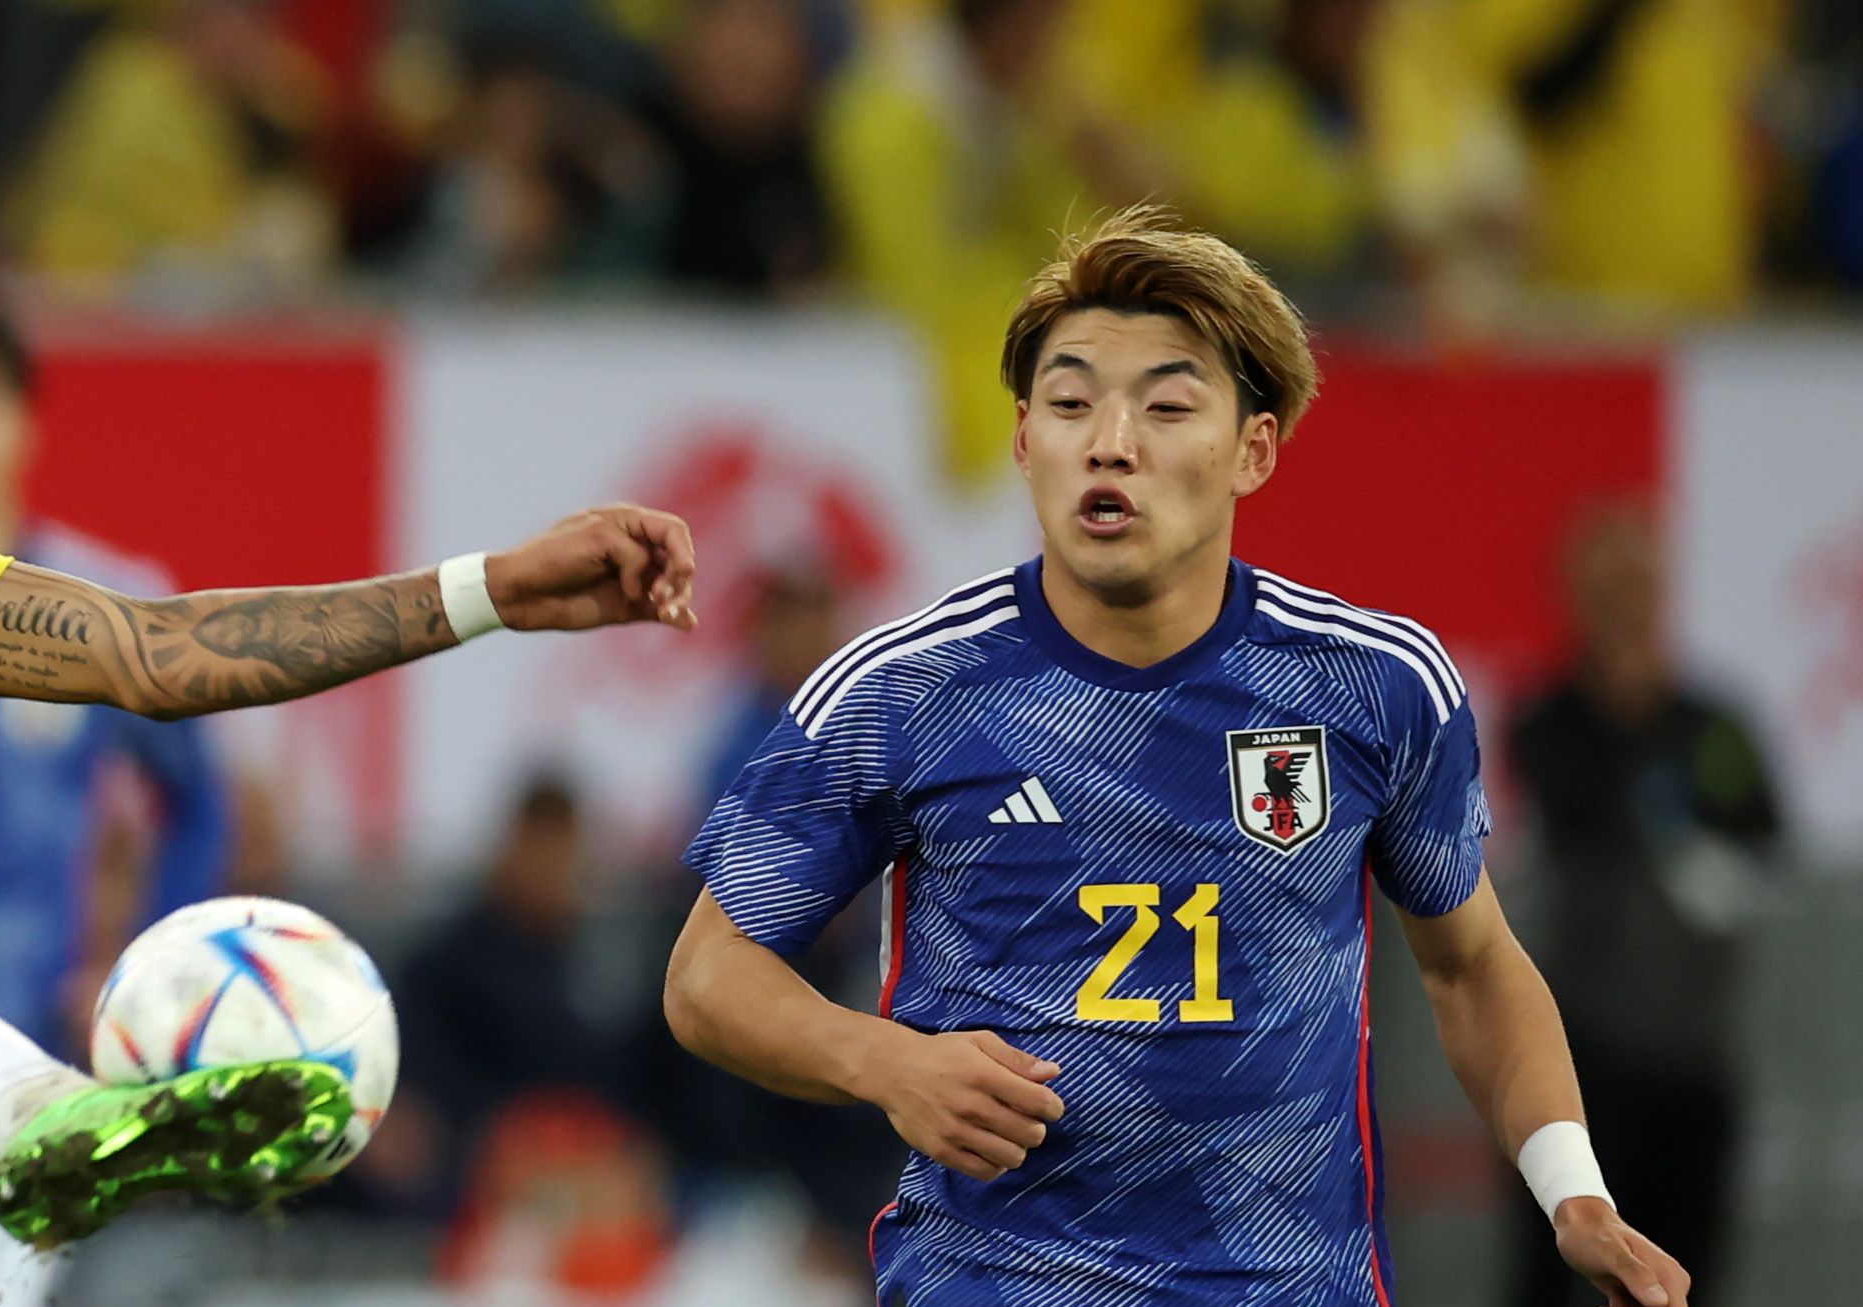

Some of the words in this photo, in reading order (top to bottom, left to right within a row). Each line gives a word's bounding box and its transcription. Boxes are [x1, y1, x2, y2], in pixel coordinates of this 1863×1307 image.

[1252, 732, 1301, 745] JAPAN
[1263, 812, 1304, 831] JFA
[1077, 884, 1234, 1022] 21
